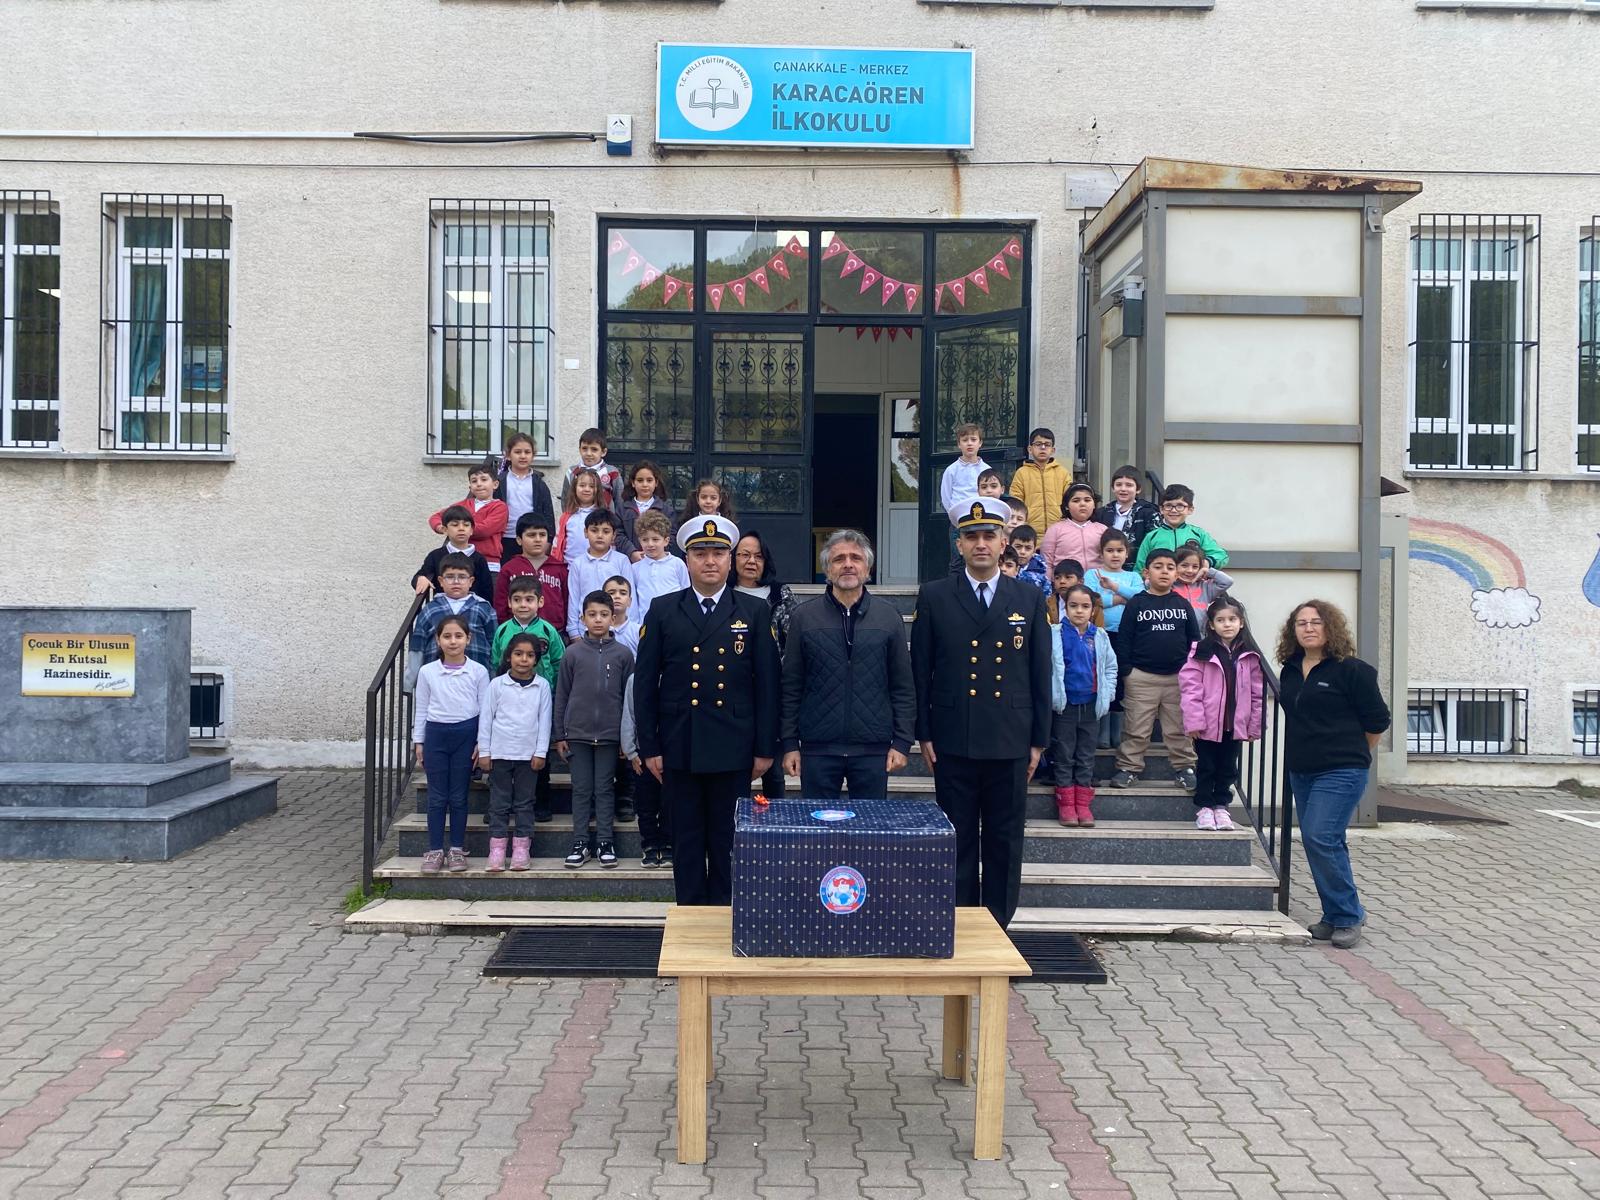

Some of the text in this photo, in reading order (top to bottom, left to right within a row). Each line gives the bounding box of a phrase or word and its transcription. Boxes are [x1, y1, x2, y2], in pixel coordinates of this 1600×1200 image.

[702, 57, 724, 65] EĞİTİM
[773, 61, 847, 74] ÇANAKKALE
[859, 64, 909, 76] MERKEZ
[772, 81, 924, 105] KARACAÖREN
[772, 104, 891, 132] İLKOKULU
[1137, 609, 1188, 621] BONJOUR
[28, 639, 130, 650] Çocuk Bir Ulusun
[49, 654, 107, 664] En Kutsal
[44, 669, 112, 680] Hazinesidir.
